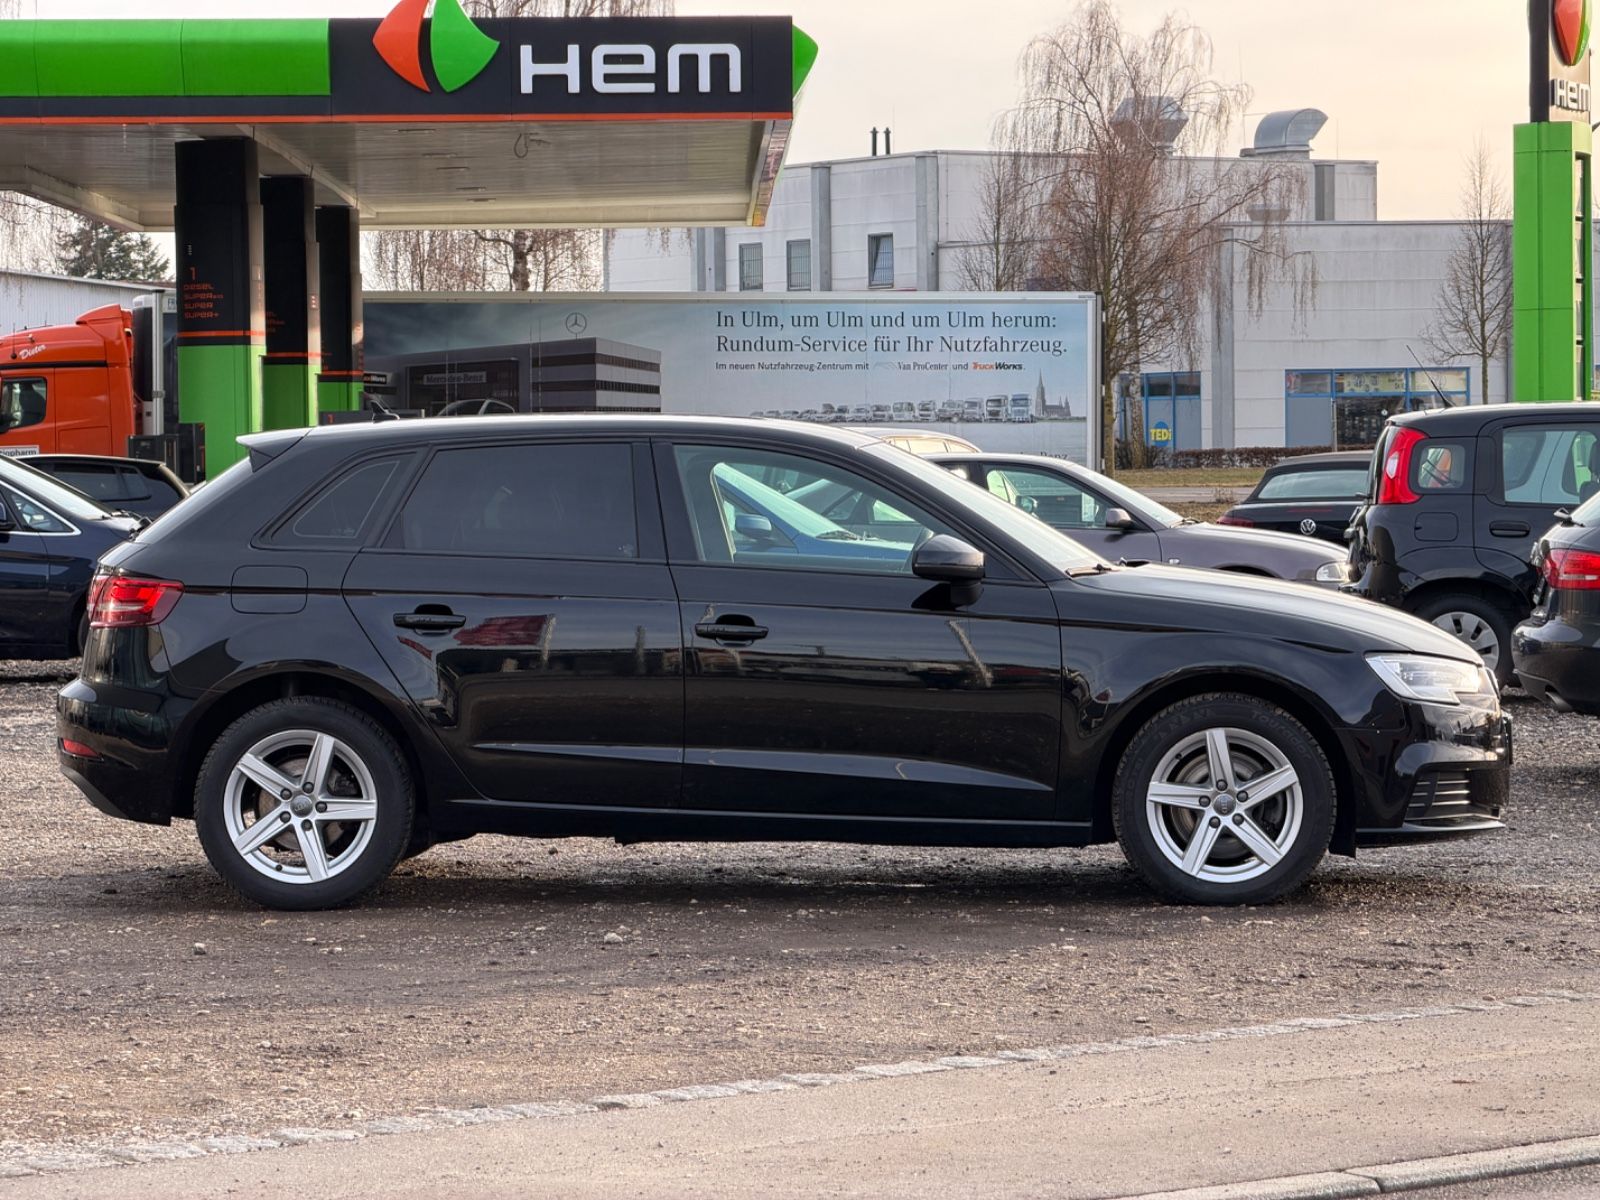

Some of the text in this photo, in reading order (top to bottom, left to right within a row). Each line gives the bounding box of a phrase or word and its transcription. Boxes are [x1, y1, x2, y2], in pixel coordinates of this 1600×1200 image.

[716, 311, 1057, 331] In Ulm, um Ulm und um Ulm herum:
[716, 335, 1068, 357] Rundum-Service für Ihr Nutzfahrzeug.
[715, 362, 727, 370] Im
[758, 361, 853, 372] Nutzfahrzeug-Zentrum
[855, 361, 870, 370] mit
[913, 361, 949, 370] ProCenter
[952, 361, 969, 370] und
